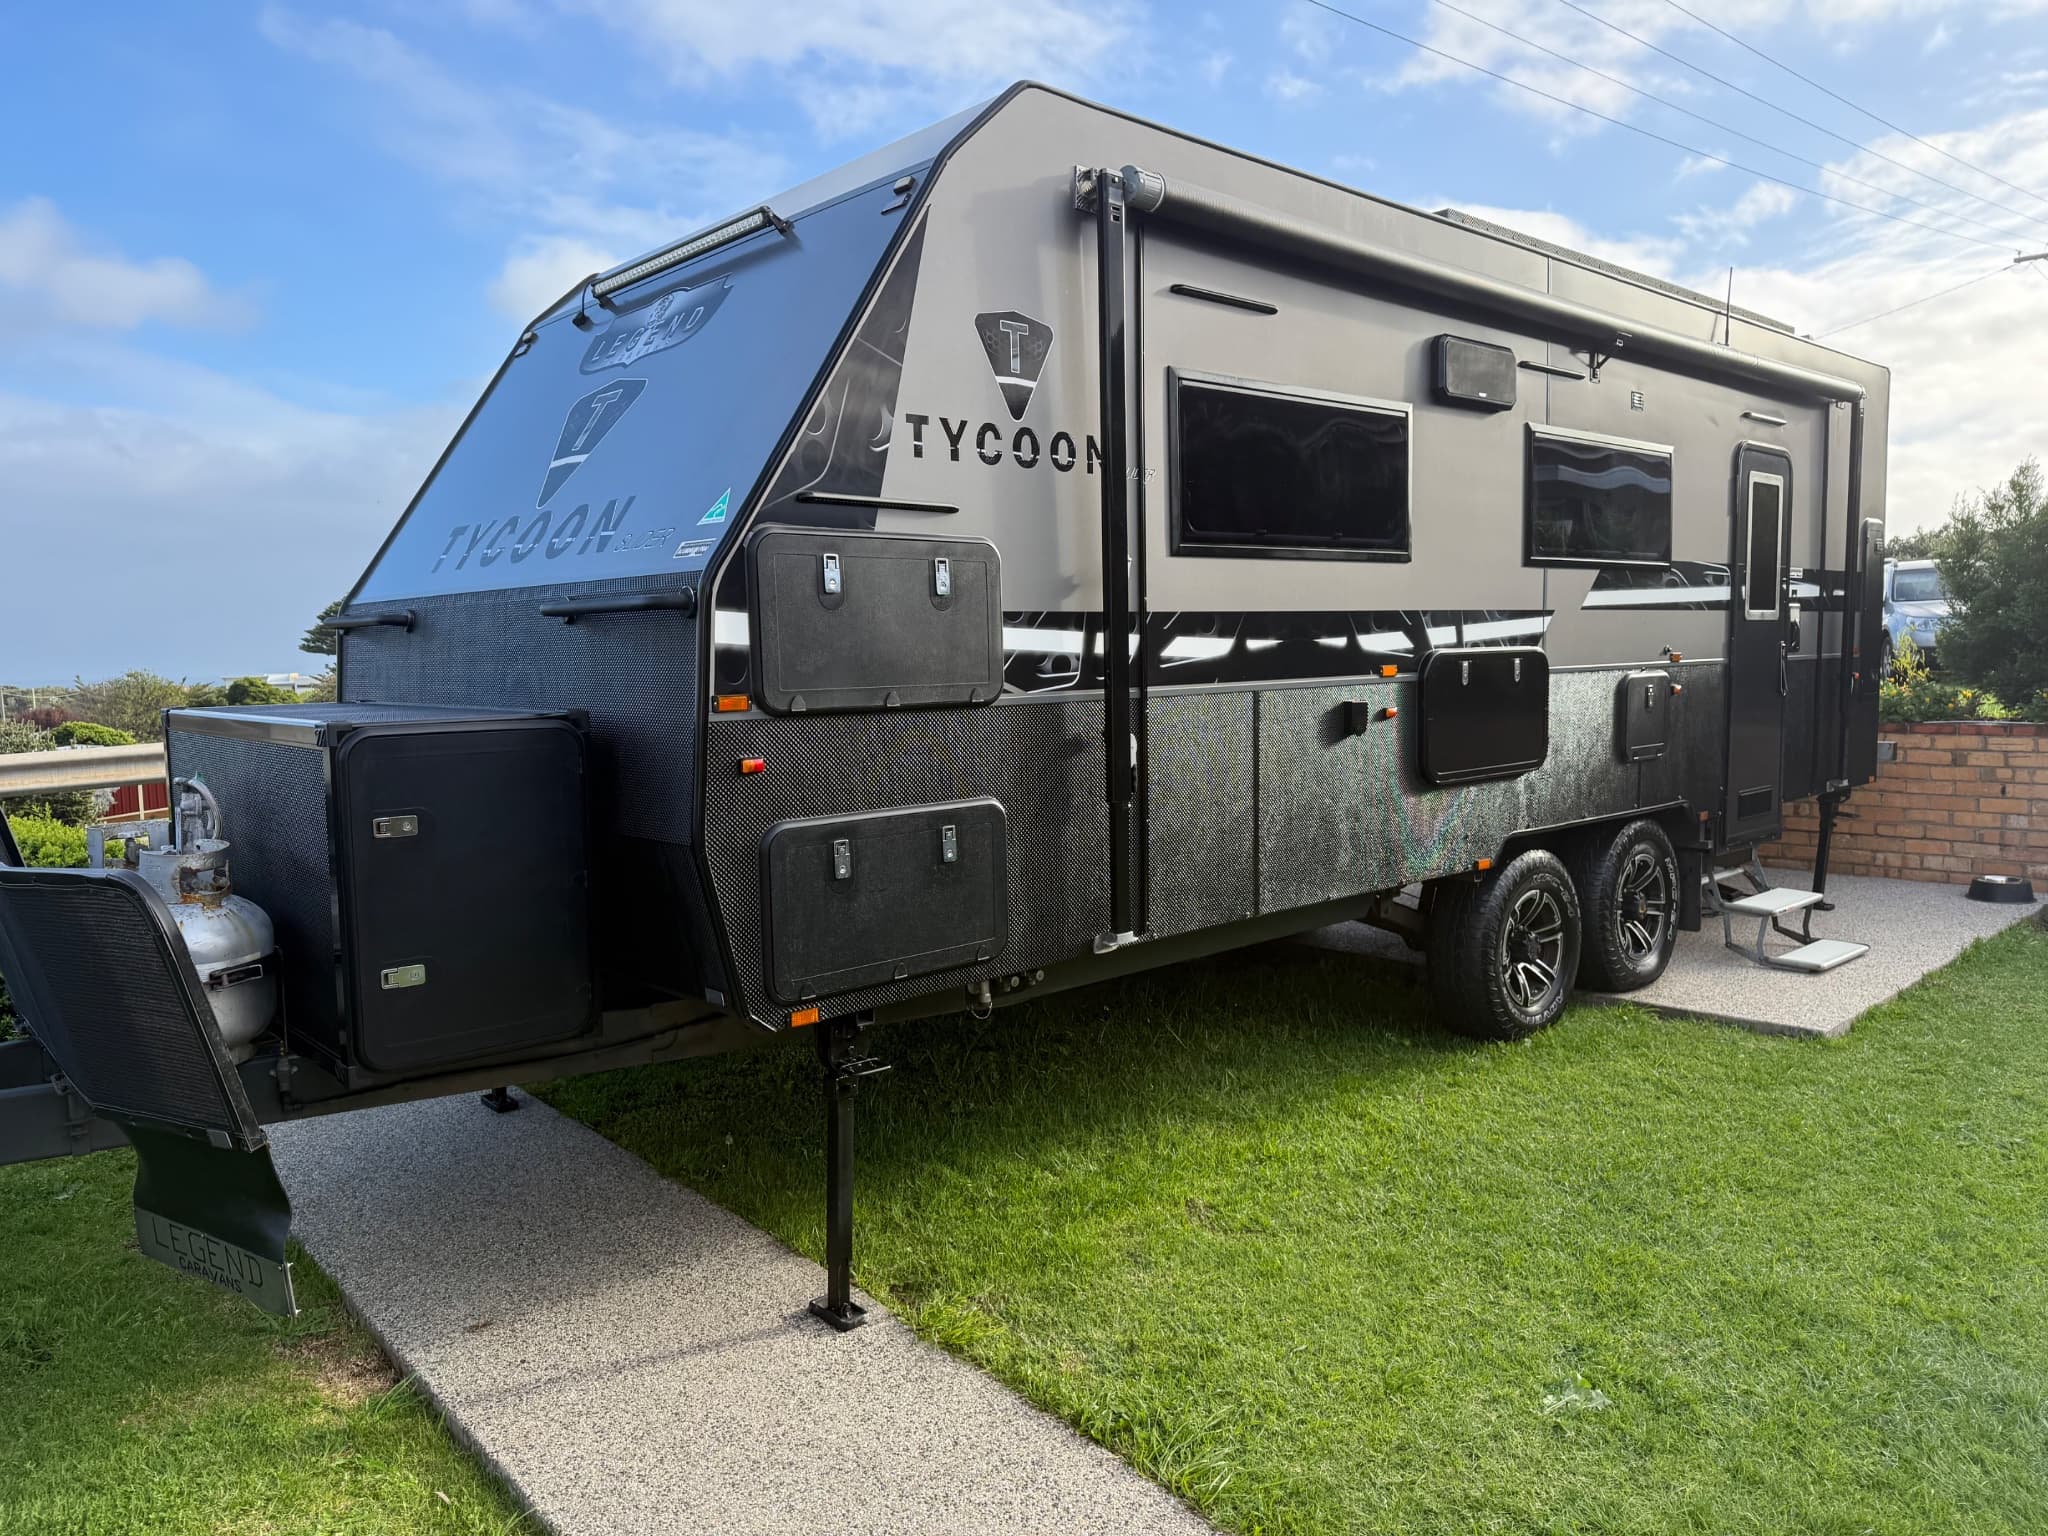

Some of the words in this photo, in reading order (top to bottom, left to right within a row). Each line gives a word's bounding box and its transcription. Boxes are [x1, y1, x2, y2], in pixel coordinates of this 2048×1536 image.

[591, 306, 705, 361] LEGEND
[1000, 320, 1028, 373] T
[571, 388, 624, 451] T
[431, 495, 637, 573] TYCOON
[152, 1216, 264, 1289] LEGEND
[178, 1255, 243, 1294] CARAVANS
